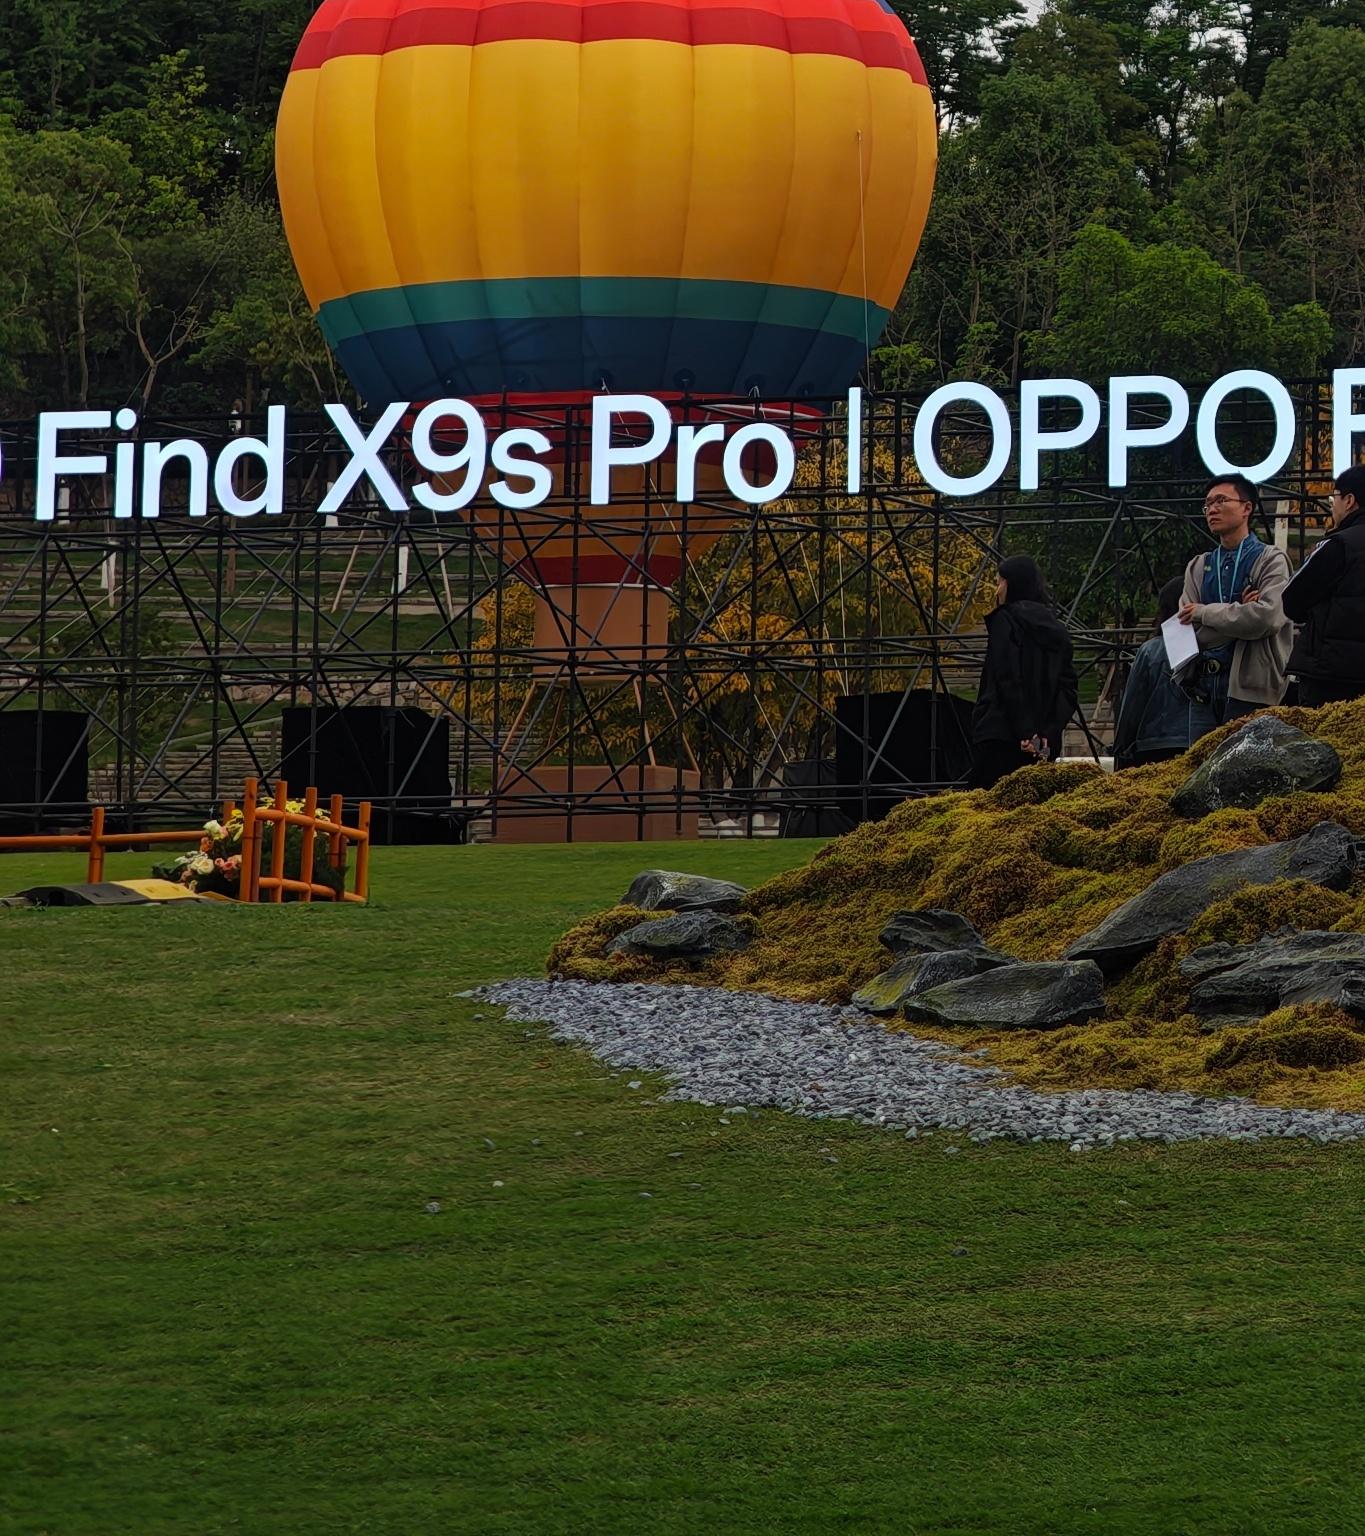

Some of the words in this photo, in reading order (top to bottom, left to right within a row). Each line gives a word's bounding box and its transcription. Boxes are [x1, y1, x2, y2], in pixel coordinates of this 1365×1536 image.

[36, 404, 285, 520] Find
[317, 398, 552, 512] X9s
[590, 394, 795, 505] Pro
[913, 369, 1296, 496] OPPO
